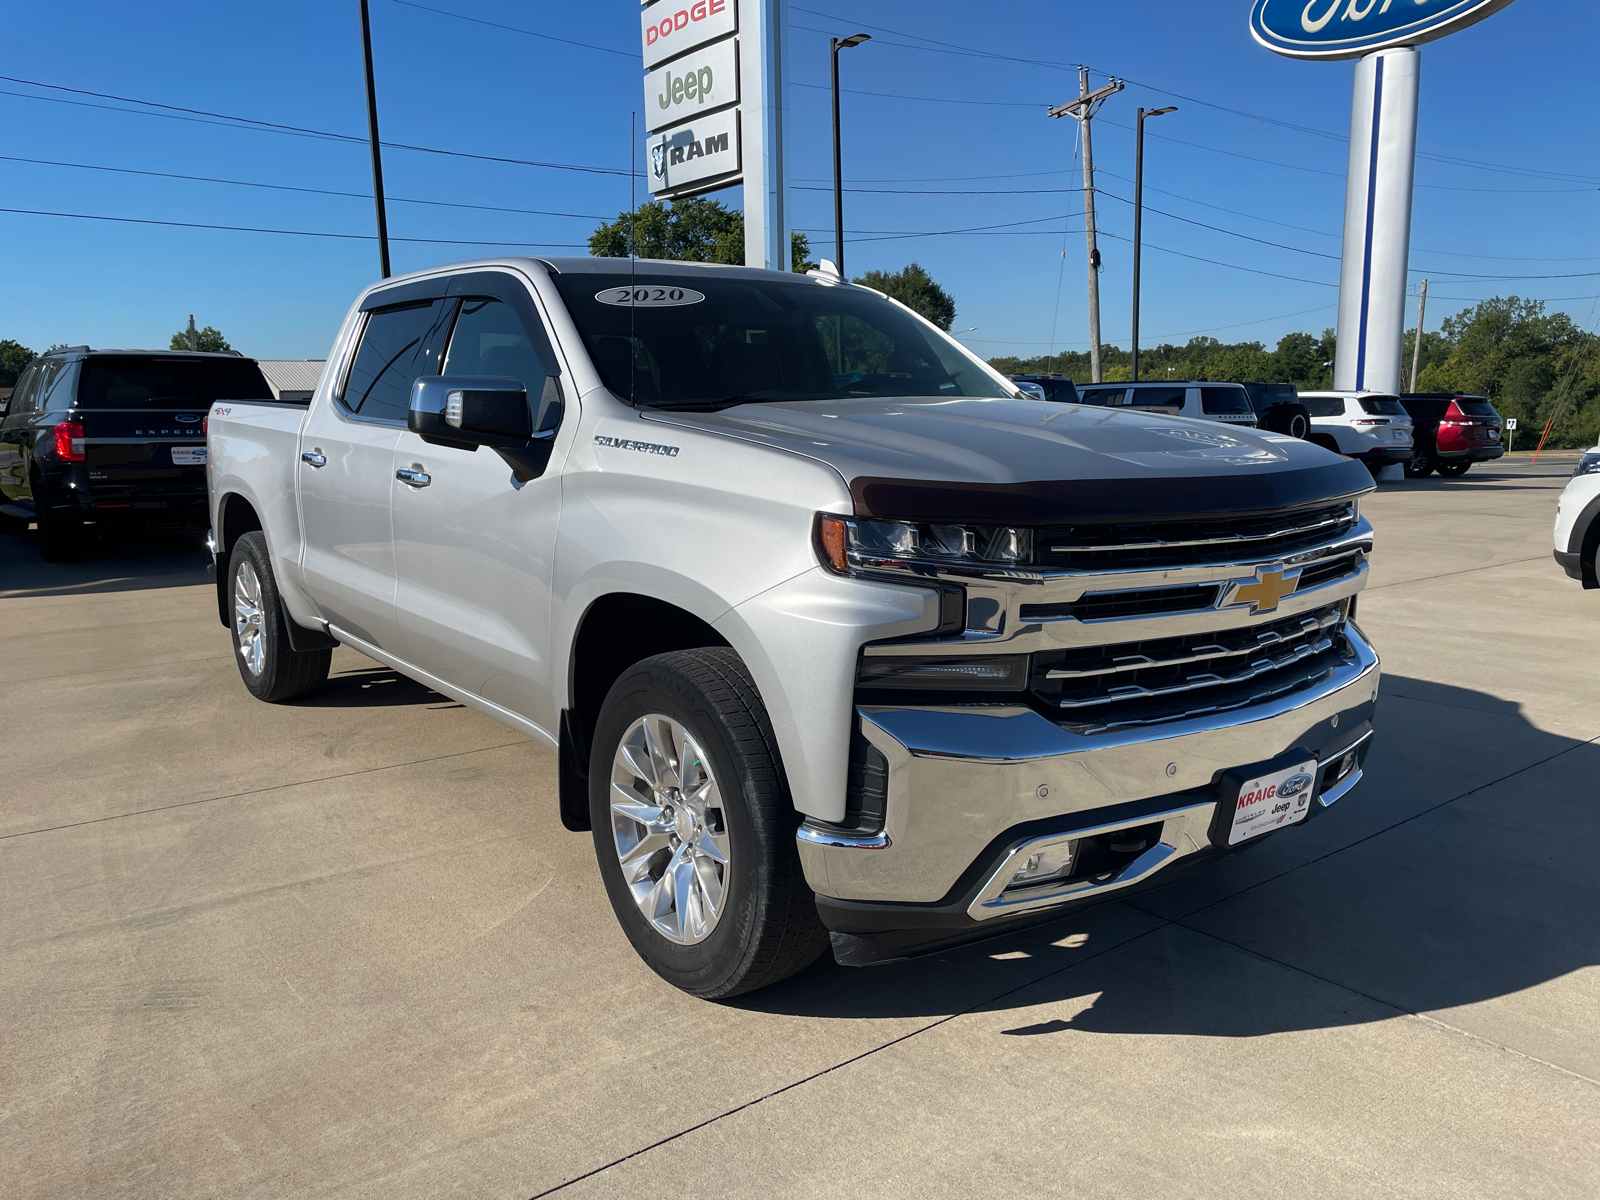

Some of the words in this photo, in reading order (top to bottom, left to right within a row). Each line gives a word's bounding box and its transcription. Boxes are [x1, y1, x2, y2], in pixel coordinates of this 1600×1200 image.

[646, 0, 726, 46] DODGE
[658, 65, 713, 110] Jeep
[670, 132, 729, 166] RAM
[616, 289, 684, 302] 2020
[593, 435, 680, 457] SILVERADO
[1237, 785, 1277, 810] KRAIG
[1282, 776, 1305, 796] Ford
[1271, 802, 1290, 814] Jeep
